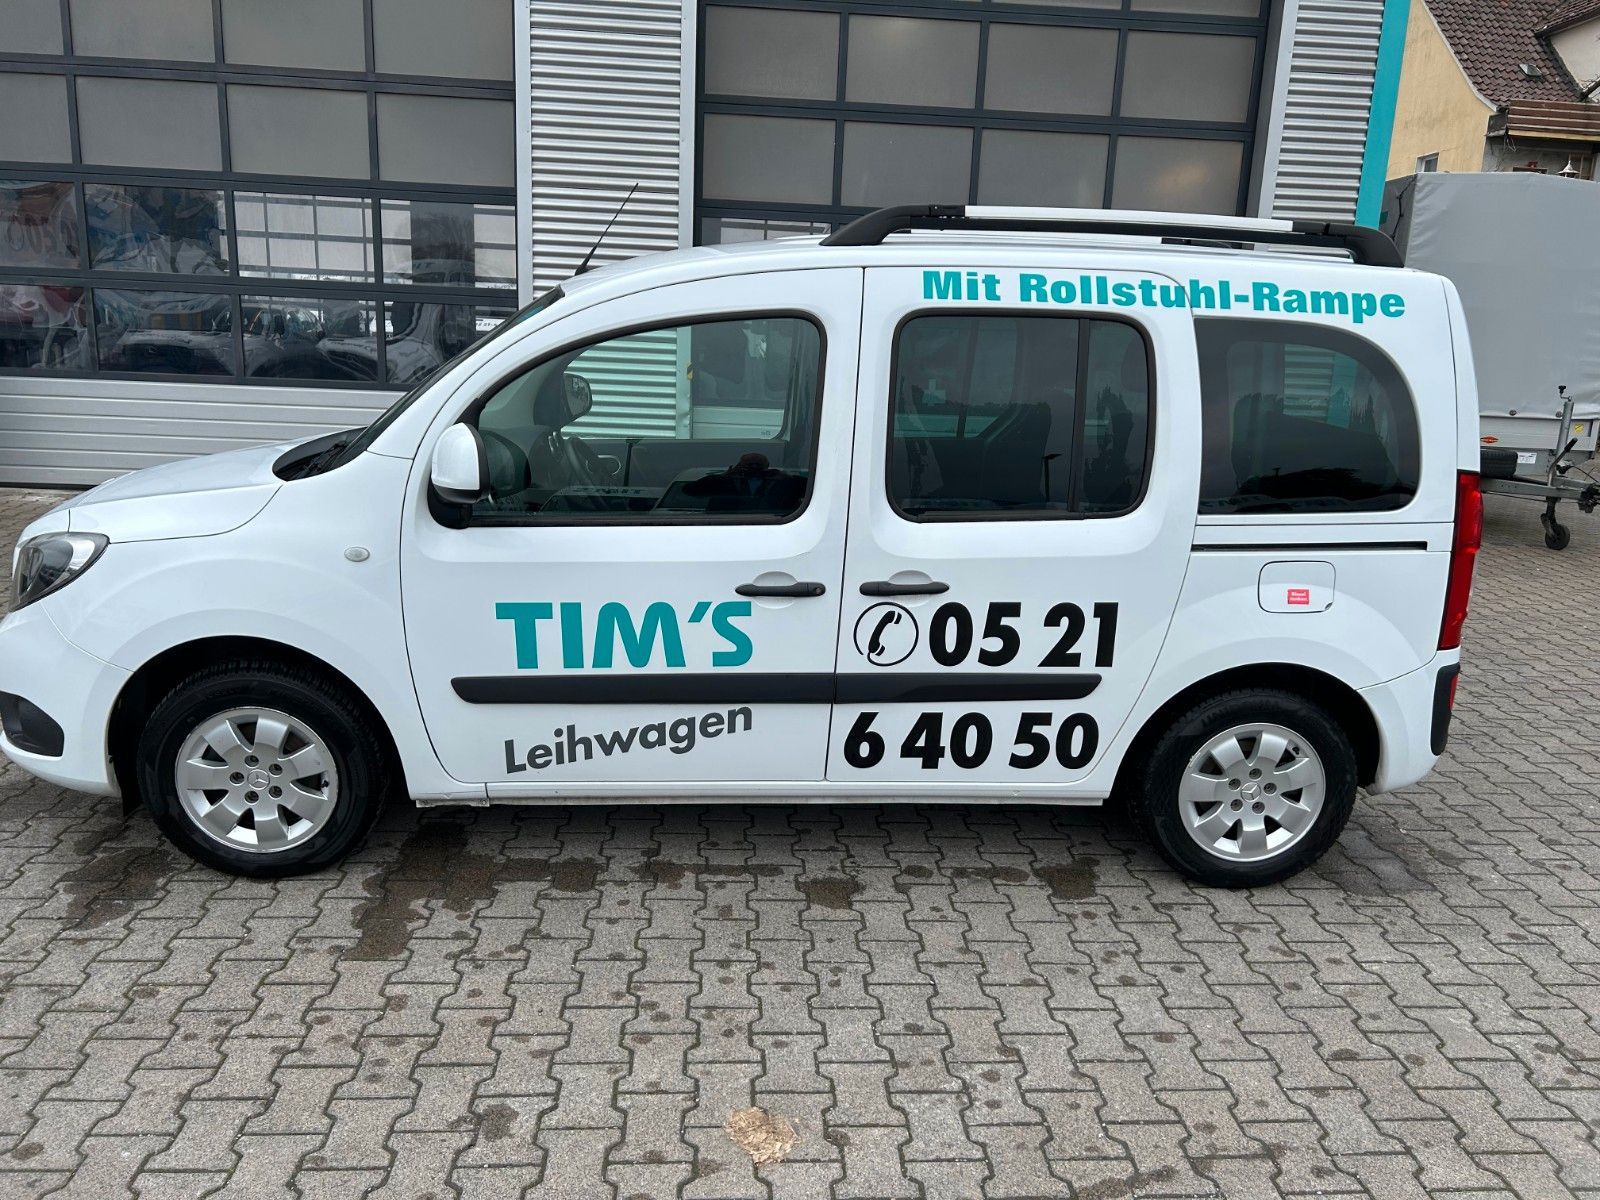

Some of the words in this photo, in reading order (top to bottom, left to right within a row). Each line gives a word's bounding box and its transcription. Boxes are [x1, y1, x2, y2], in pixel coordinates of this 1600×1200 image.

[922, 269, 1002, 303] Mit
[1018, 271, 1406, 326] Rollstuhl-Rampe
[494, 599, 754, 671] TIM'S
[928, 600, 1022, 667] 05
[1037, 602, 1119, 668] 21
[504, 706, 753, 774] Leihwagen
[843, 711, 886, 769] 6
[899, 711, 994, 770] 40
[1008, 712, 1100, 770] 50
